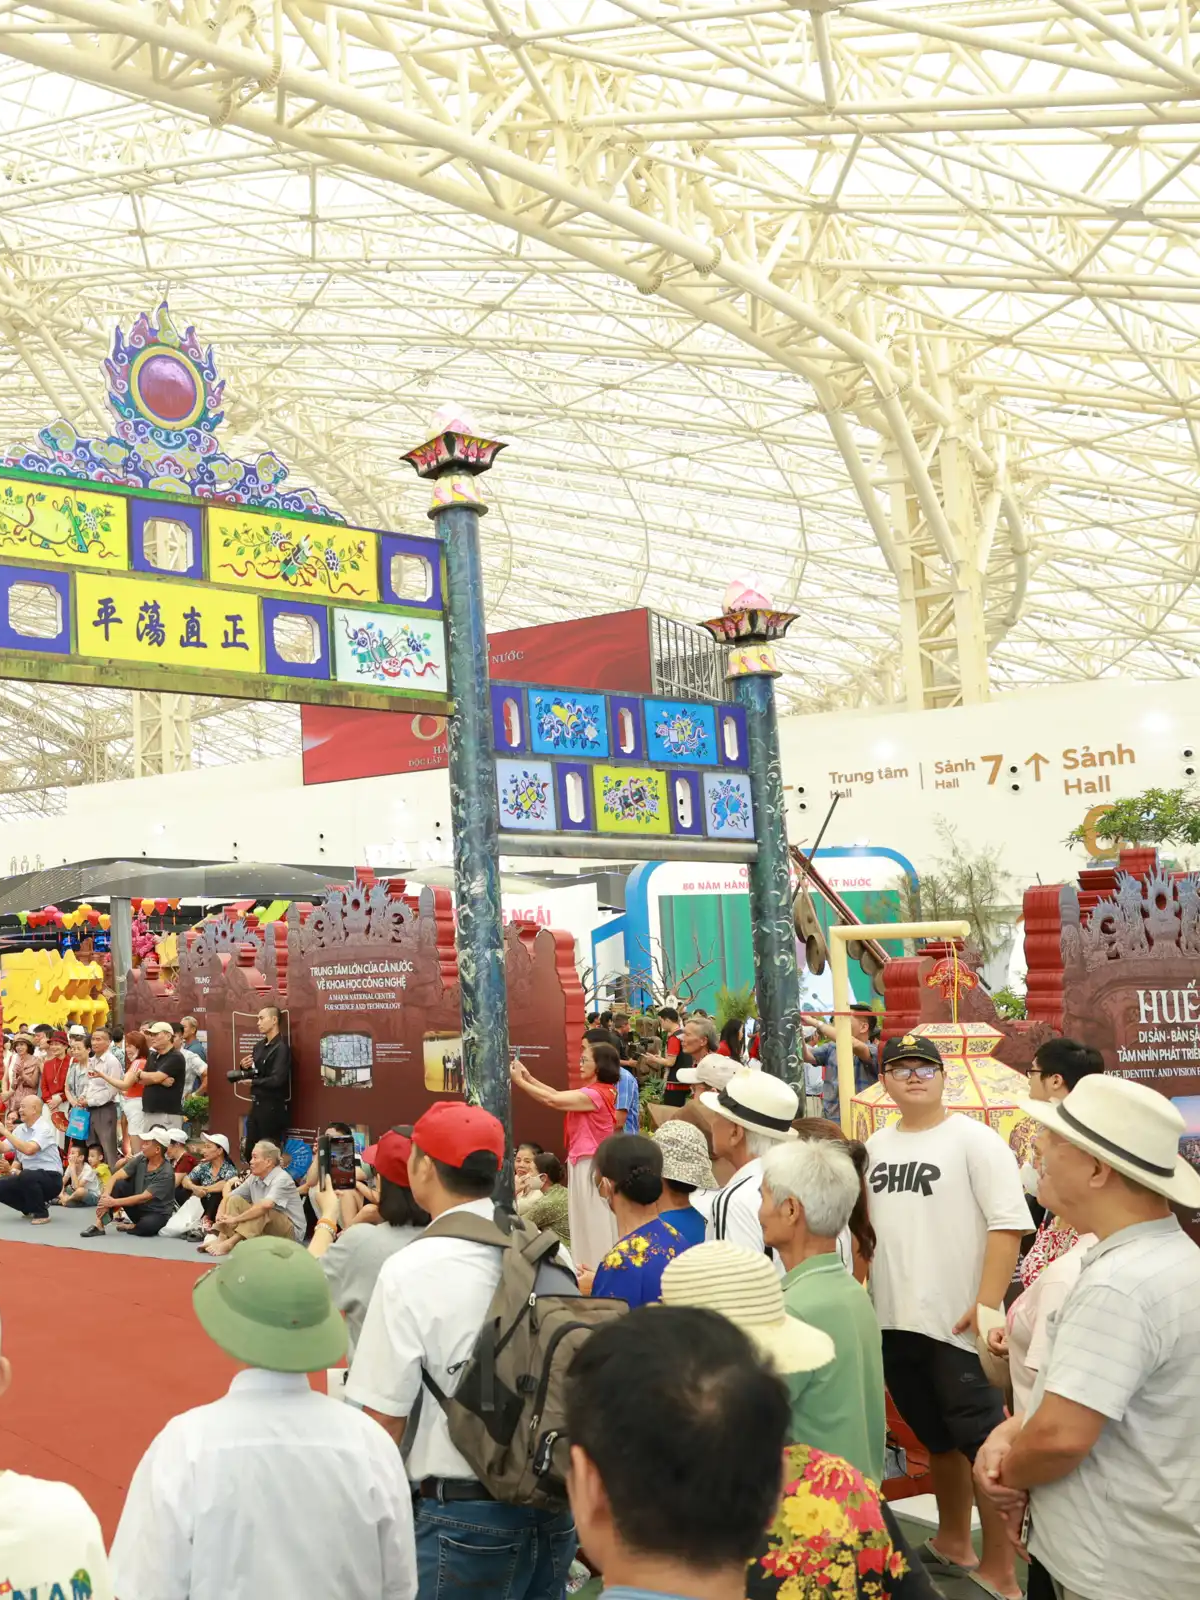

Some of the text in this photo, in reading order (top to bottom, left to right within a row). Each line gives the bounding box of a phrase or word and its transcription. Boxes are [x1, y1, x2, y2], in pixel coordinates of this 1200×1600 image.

[492, 650, 524, 665] NƯỚC
[1062, 743, 1136, 770] Sảnh
[829, 766, 909, 785] Trung tâm
[934, 754, 1003, 785] Sảnh 7
[935, 778, 959, 790] Hall
[1064, 775, 1111, 795] Hall
[842, 877, 872, 887] NƯỚC
[310, 959, 414, 977] TRUNG TÂM LỚN CỦA CẢ NƯỚC
[326, 979, 346, 989] KHOA
[346, 978, 362, 991] HỌC
[362, 976, 383, 988] CÔNG
[383, 975, 406, 990] NGHỆ
[374, 992, 396, 1000] CENTER
[1136, 979, 1200, 1024] HUẾ
[367, 1002, 401, 1010] TECHNOLOGY
[1138, 1031, 1148, 1043] DI
[1148, 1027, 1166, 1043] SẢN
[1171, 1027, 1189, 1042] BẢN
[1189, 1024, 1200, 1041] SẮ
[1117, 1040, 1200, 1062] TẦM NHÌN PHÁT TRIỂ
[1158, 1068, 1172, 1078] AND
[1173, 1067, 1197, 1077] VISION
[869, 1161, 941, 1196] SHIR
